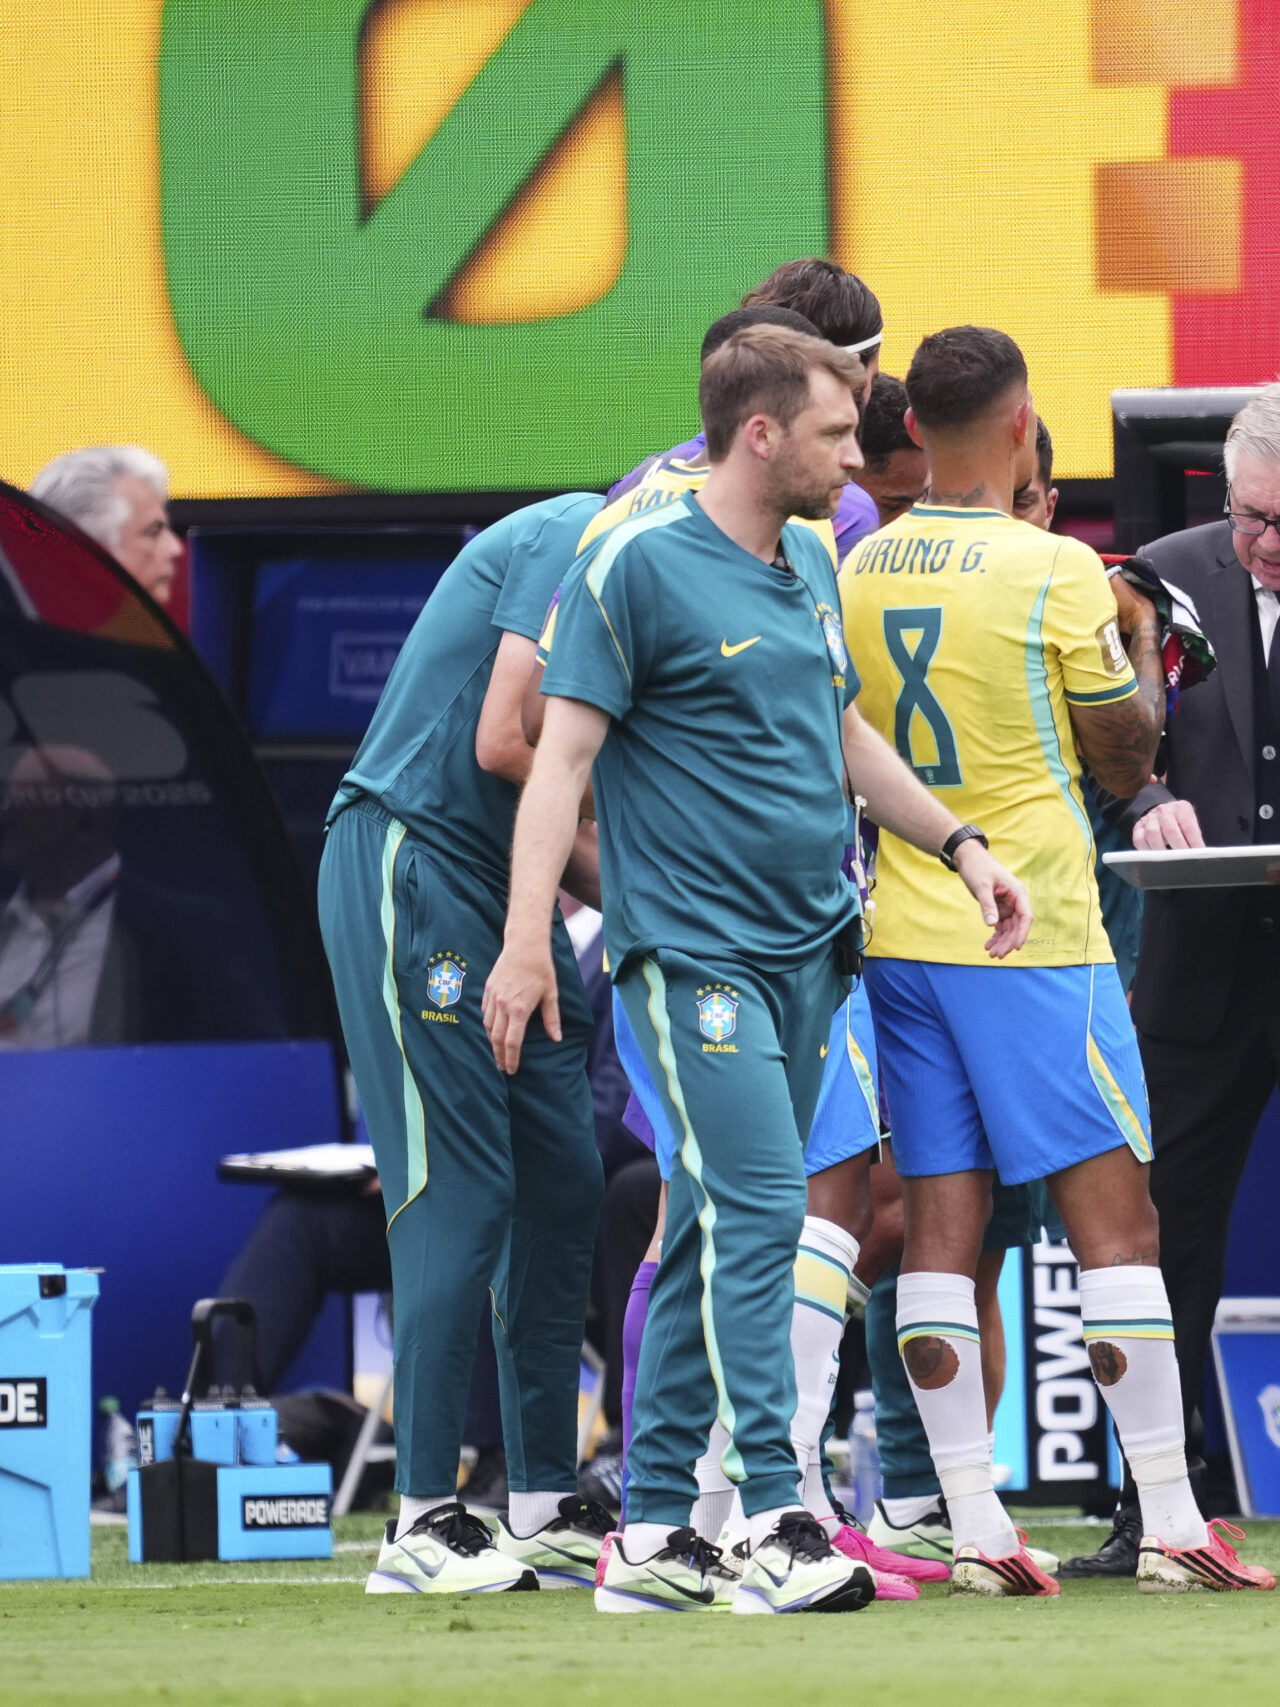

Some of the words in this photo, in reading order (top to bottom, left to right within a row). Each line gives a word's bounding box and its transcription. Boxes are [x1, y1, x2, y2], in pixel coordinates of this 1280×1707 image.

[855, 538, 955, 575] BRUNO
[960, 541, 988, 573] G.
[882, 605, 965, 788] 8
[421, 1010, 459, 1023] BRASIL
[702, 1043, 739, 1053] BRASIL
[245, 1499, 327, 1525] POWERADE
